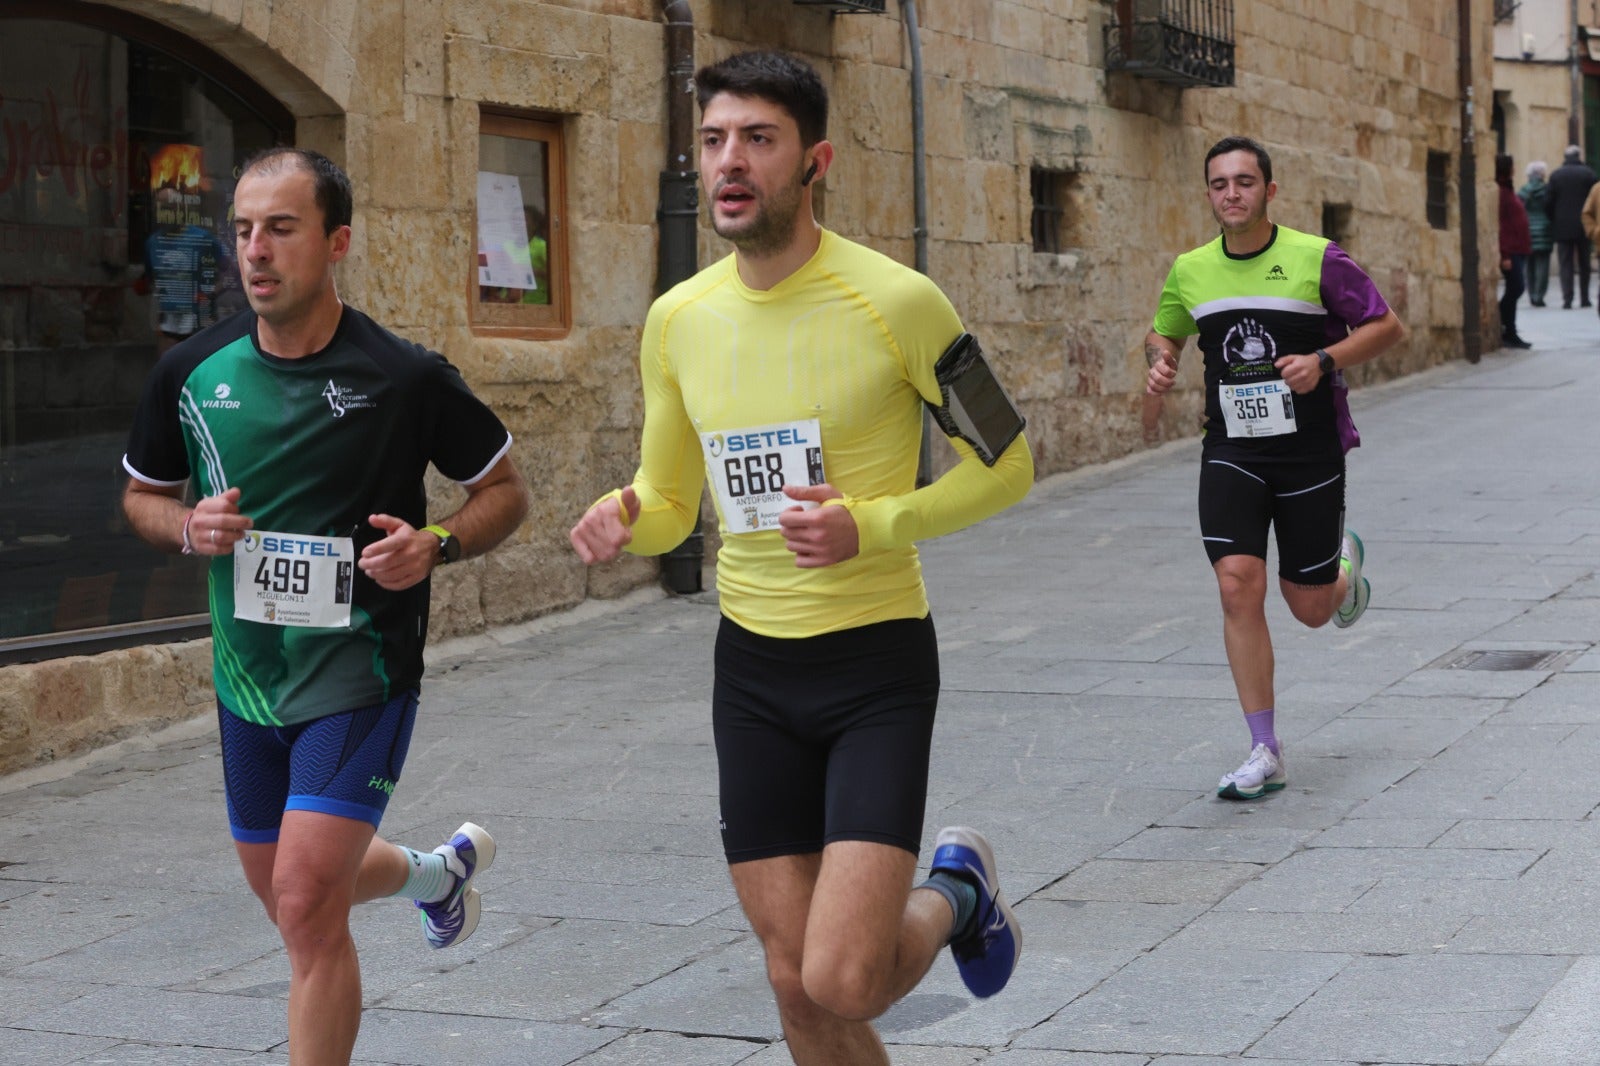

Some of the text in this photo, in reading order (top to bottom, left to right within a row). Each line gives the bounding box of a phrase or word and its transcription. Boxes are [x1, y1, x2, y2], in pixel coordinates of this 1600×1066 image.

[1235, 384, 1283, 397] SETEL
[202, 399, 241, 410] VIATOR
[1234, 397, 1269, 419] 356
[727, 428, 808, 452] SETEL
[724, 452, 785, 497] 668
[262, 537, 341, 557] SETEL
[254, 556, 311, 595] 499
[256, 591, 305, 603] MIGUELON11
